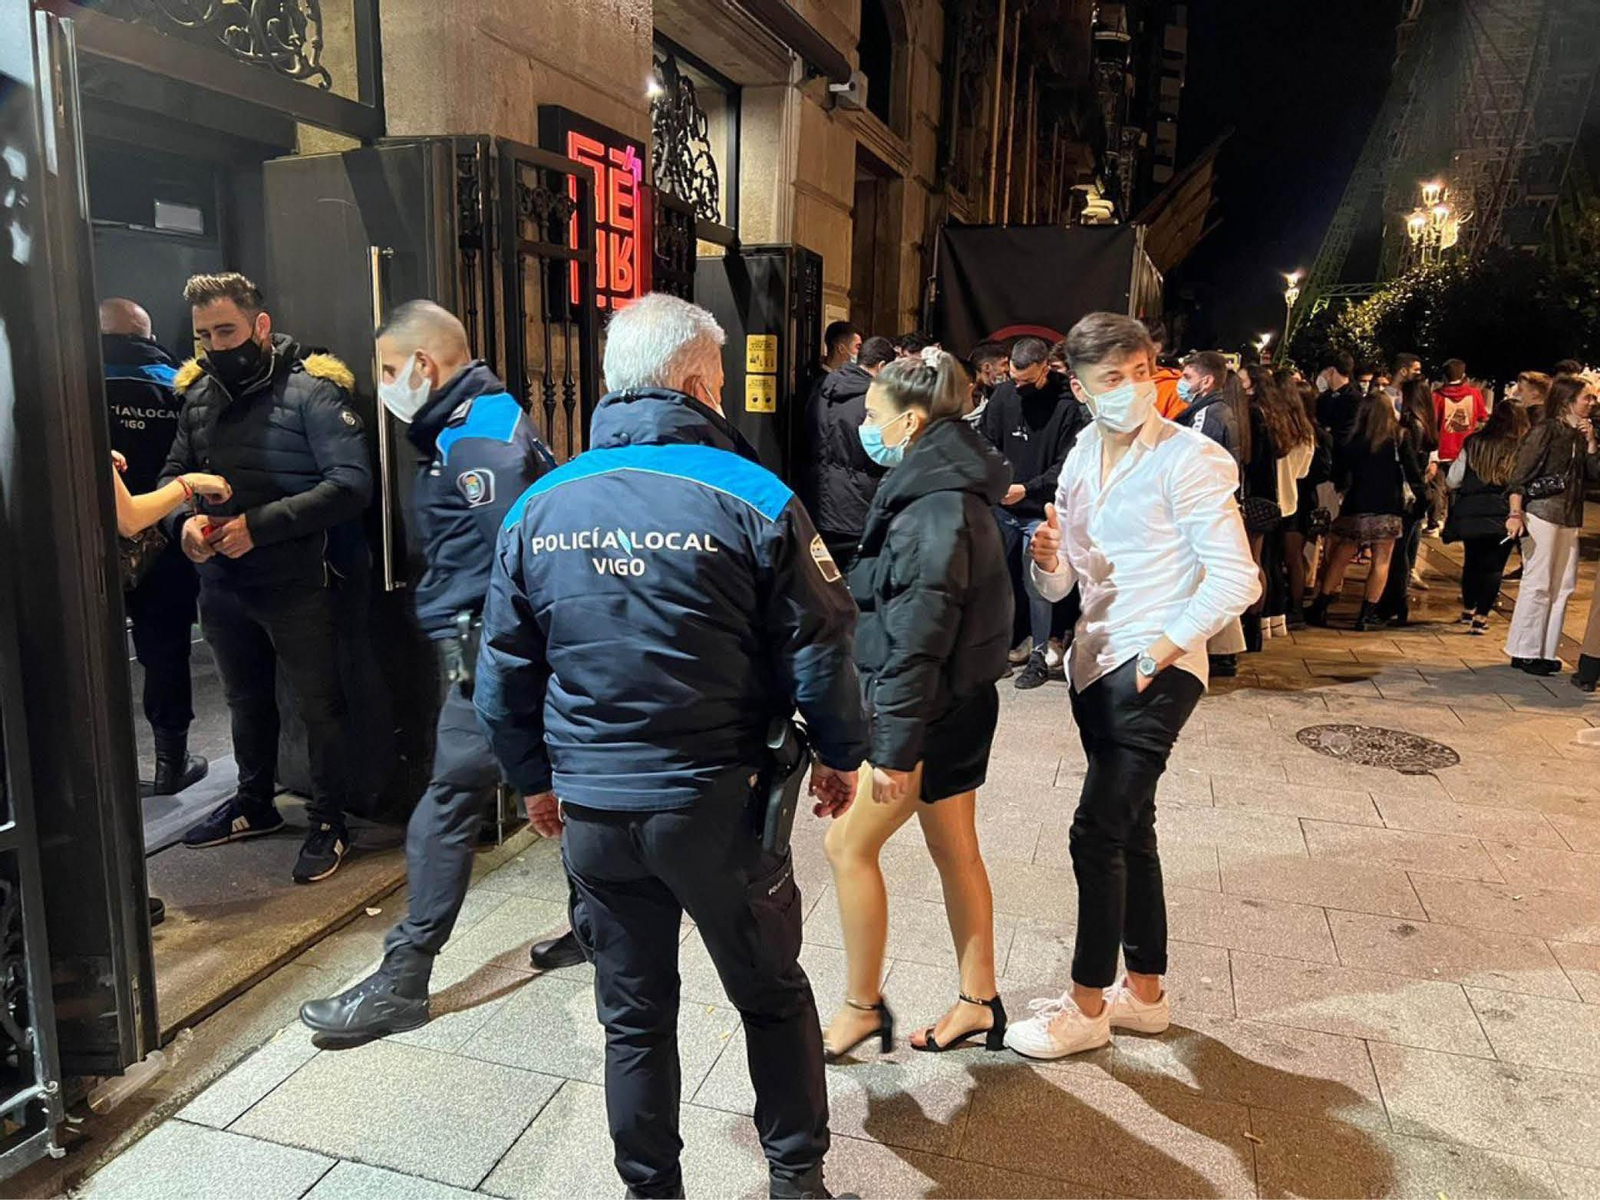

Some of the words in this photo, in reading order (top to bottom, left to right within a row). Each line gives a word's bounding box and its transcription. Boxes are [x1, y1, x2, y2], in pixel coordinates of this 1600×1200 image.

[120, 419, 146, 430] IGO
[532, 527, 619, 555] POLICÍA
[630, 531, 719, 552] LOCAL
[592, 557, 645, 577] VIGO
